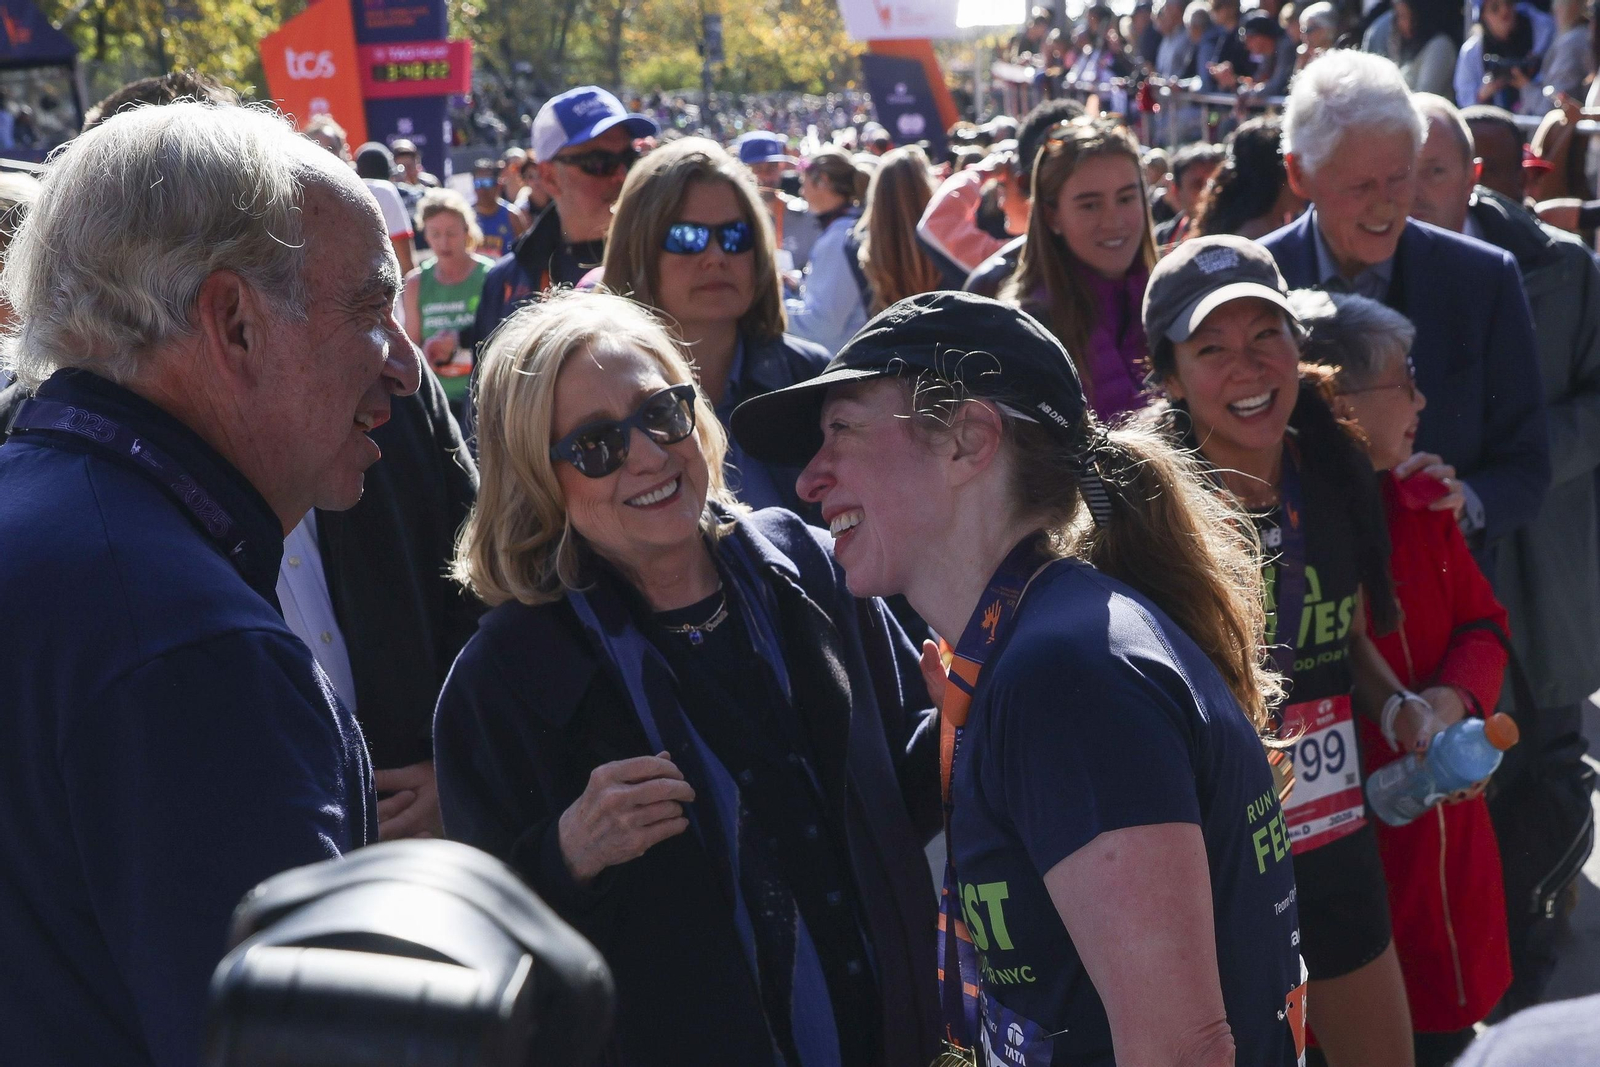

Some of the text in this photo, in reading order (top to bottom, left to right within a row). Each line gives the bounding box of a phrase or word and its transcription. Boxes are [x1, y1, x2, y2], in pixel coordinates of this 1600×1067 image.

[284, 46, 336, 81] tcs
[423, 312, 475, 328] IRELAN
[52, 405, 120, 443] 2025
[171, 474, 235, 539] 2025
[1247, 789, 1273, 824] RUN
[1252, 809, 1291, 874] FEE
[957, 881, 1015, 950] ST
[995, 965, 1036, 985] NYC
[1003, 1043, 1026, 1067] TATA
